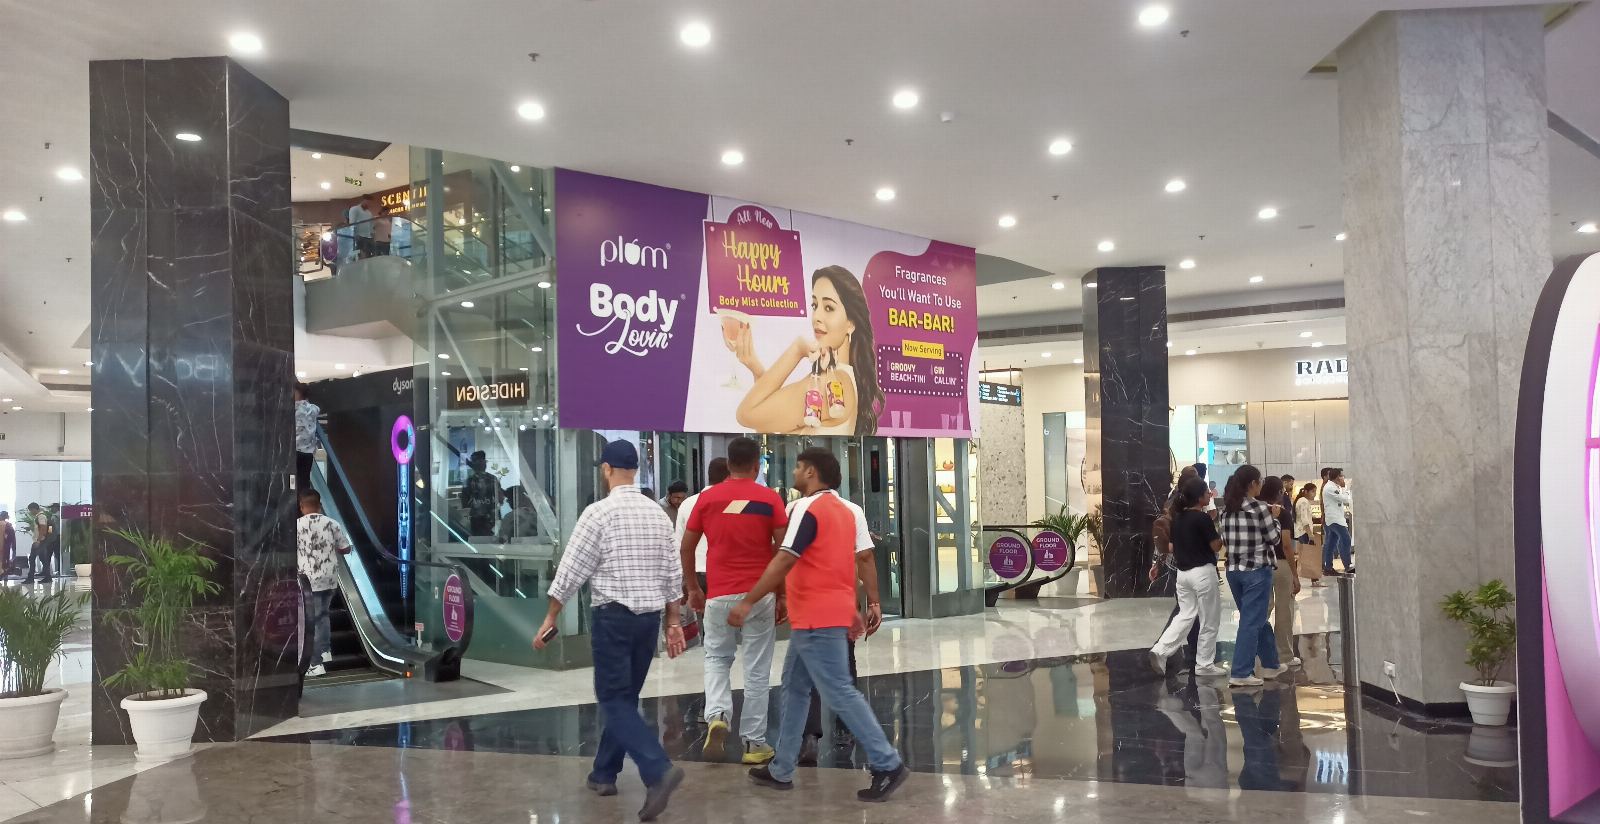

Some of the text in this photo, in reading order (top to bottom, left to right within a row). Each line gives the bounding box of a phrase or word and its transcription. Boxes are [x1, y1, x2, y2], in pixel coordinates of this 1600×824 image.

[737, 210, 773, 229] All New
[722, 230, 781, 269] Happy
[737, 264, 790, 295] Hours
[895, 265, 947, 286] Fragrances
[719, 295, 799, 309] Body Mist Collection
[879, 284, 962, 309] You'll Want To Use
[589, 282, 679, 333] Body
[888, 307, 955, 333] BAR-BAR!
[904, 343, 942, 357] Now Serving
[890, 362, 916, 373] GROOVY
[933, 366, 945, 375] GIN
[392, 376, 414, 394] dyson
[890, 373, 926, 384] BEACH-TINI
